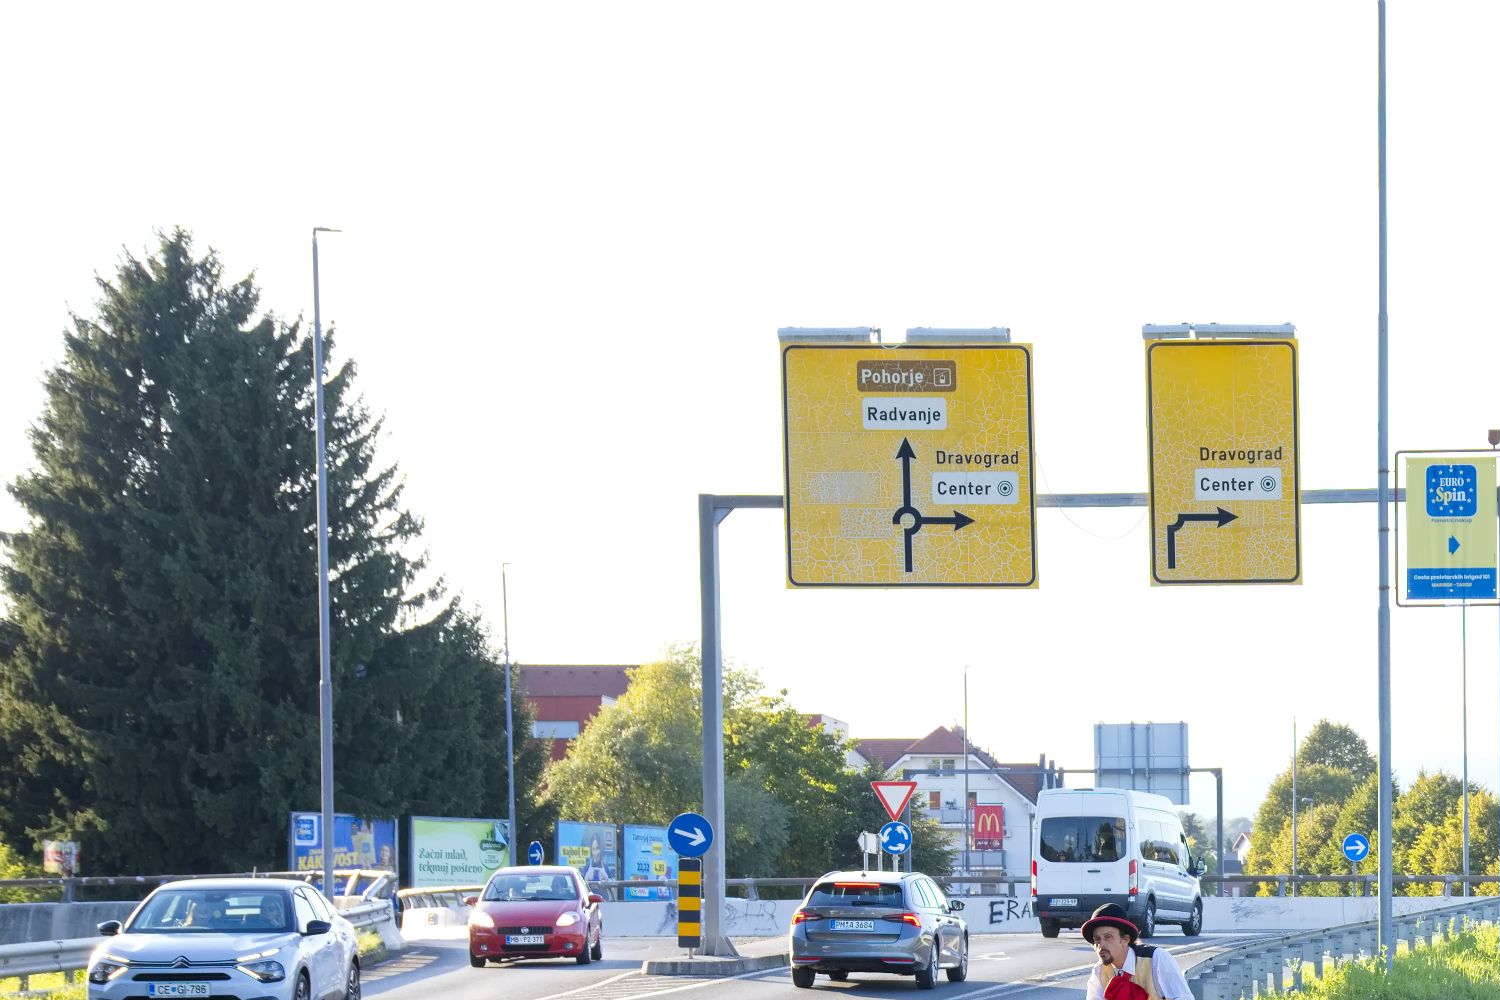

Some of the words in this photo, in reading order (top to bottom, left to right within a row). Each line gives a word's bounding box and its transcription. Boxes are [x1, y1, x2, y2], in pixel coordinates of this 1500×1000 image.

[861, 368, 924, 387] Pohorje
[867, 406, 941, 426] Radvanje
[935, 450, 1020, 468] Dravograd
[1199, 446, 1283, 464] Dravograd
[937, 480, 991, 496] Center
[1200, 476, 1254, 492] Center
[1440, 477, 1465, 487] EURO
[1436, 486, 1467, 506] Spin
[298, 851, 360, 871] KAKVOST
[418, 847, 443, 860] Začni
[445, 848, 468, 861] mlad,
[418, 861, 449, 874] tekmuj
[450, 862, 483, 876] pošteno
[157, 985, 171, 995] CE
